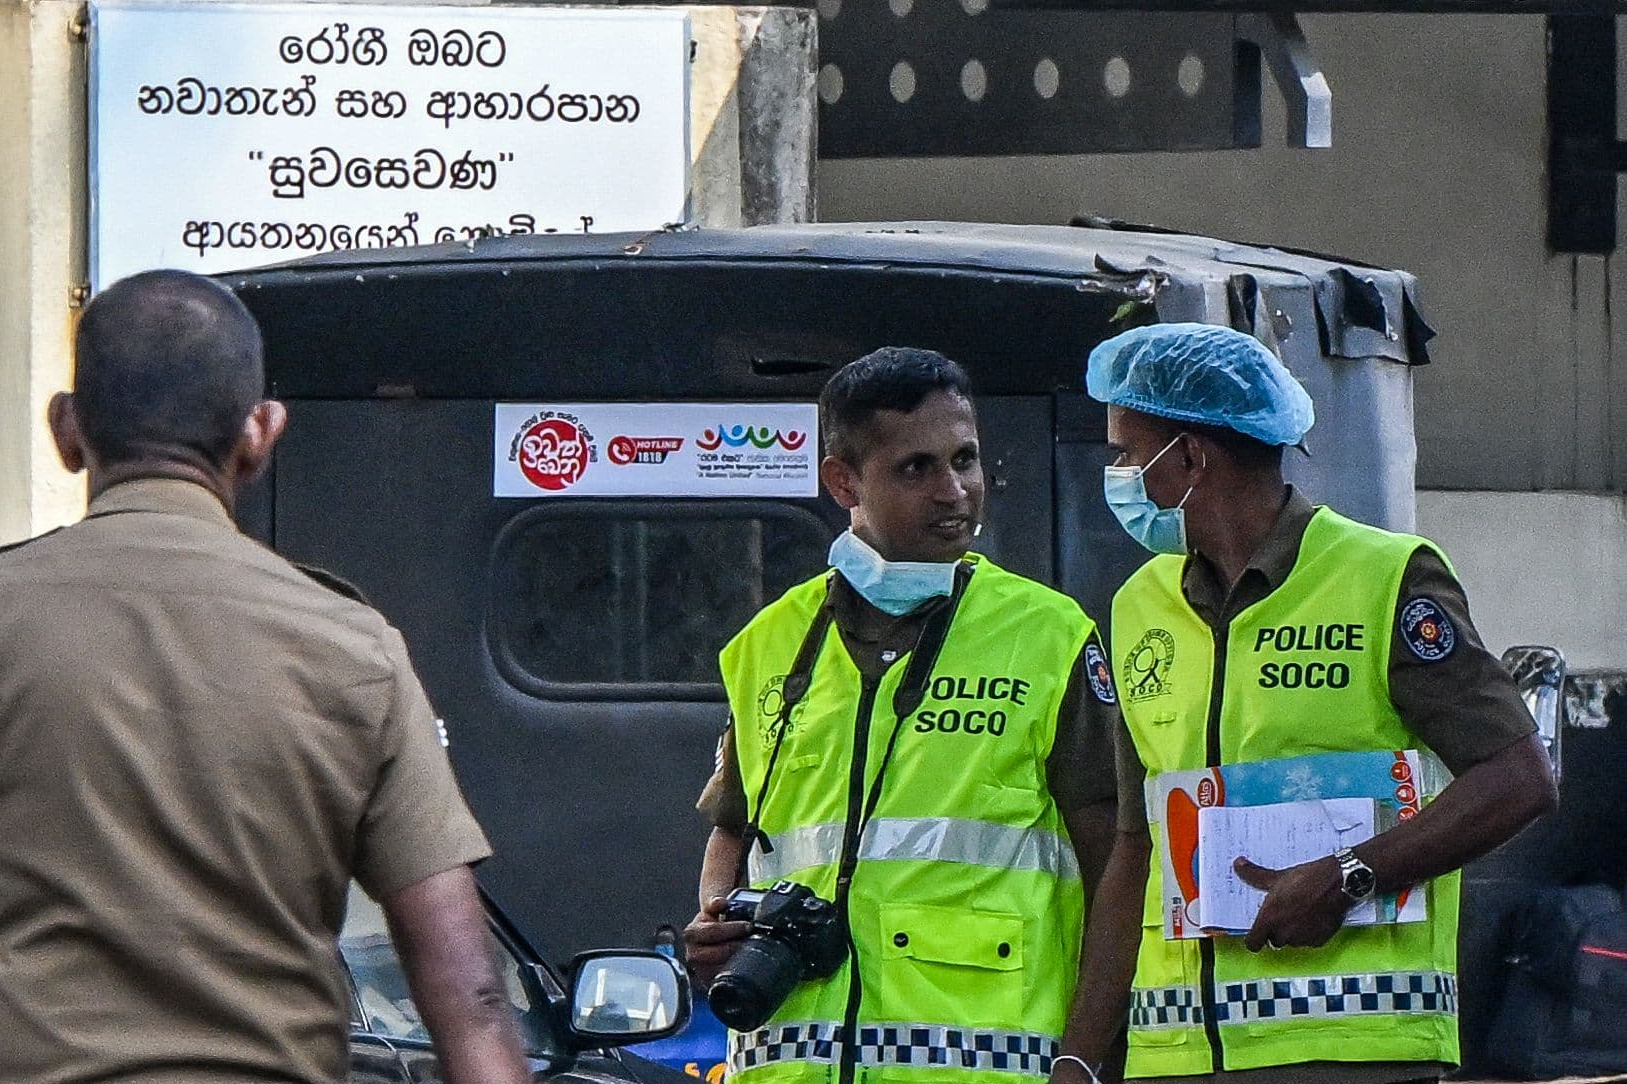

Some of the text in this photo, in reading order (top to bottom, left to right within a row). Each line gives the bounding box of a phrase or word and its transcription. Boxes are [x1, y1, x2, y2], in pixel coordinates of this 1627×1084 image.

[407, 28, 507, 68] ඔබට
[138, 74, 641, 129] නවාතැන් සහ ආහාරපාන
[637, 440, 678, 449] HOTLINE
[638, 451, 662, 462] 1818
[1254, 623, 1364, 652] POLICE
[1129, 683, 1163, 697] SOCO
[1258, 662, 1351, 690] SOCO
[923, 676, 1031, 706] OLICE
[914, 709, 1007, 737] SOCO
